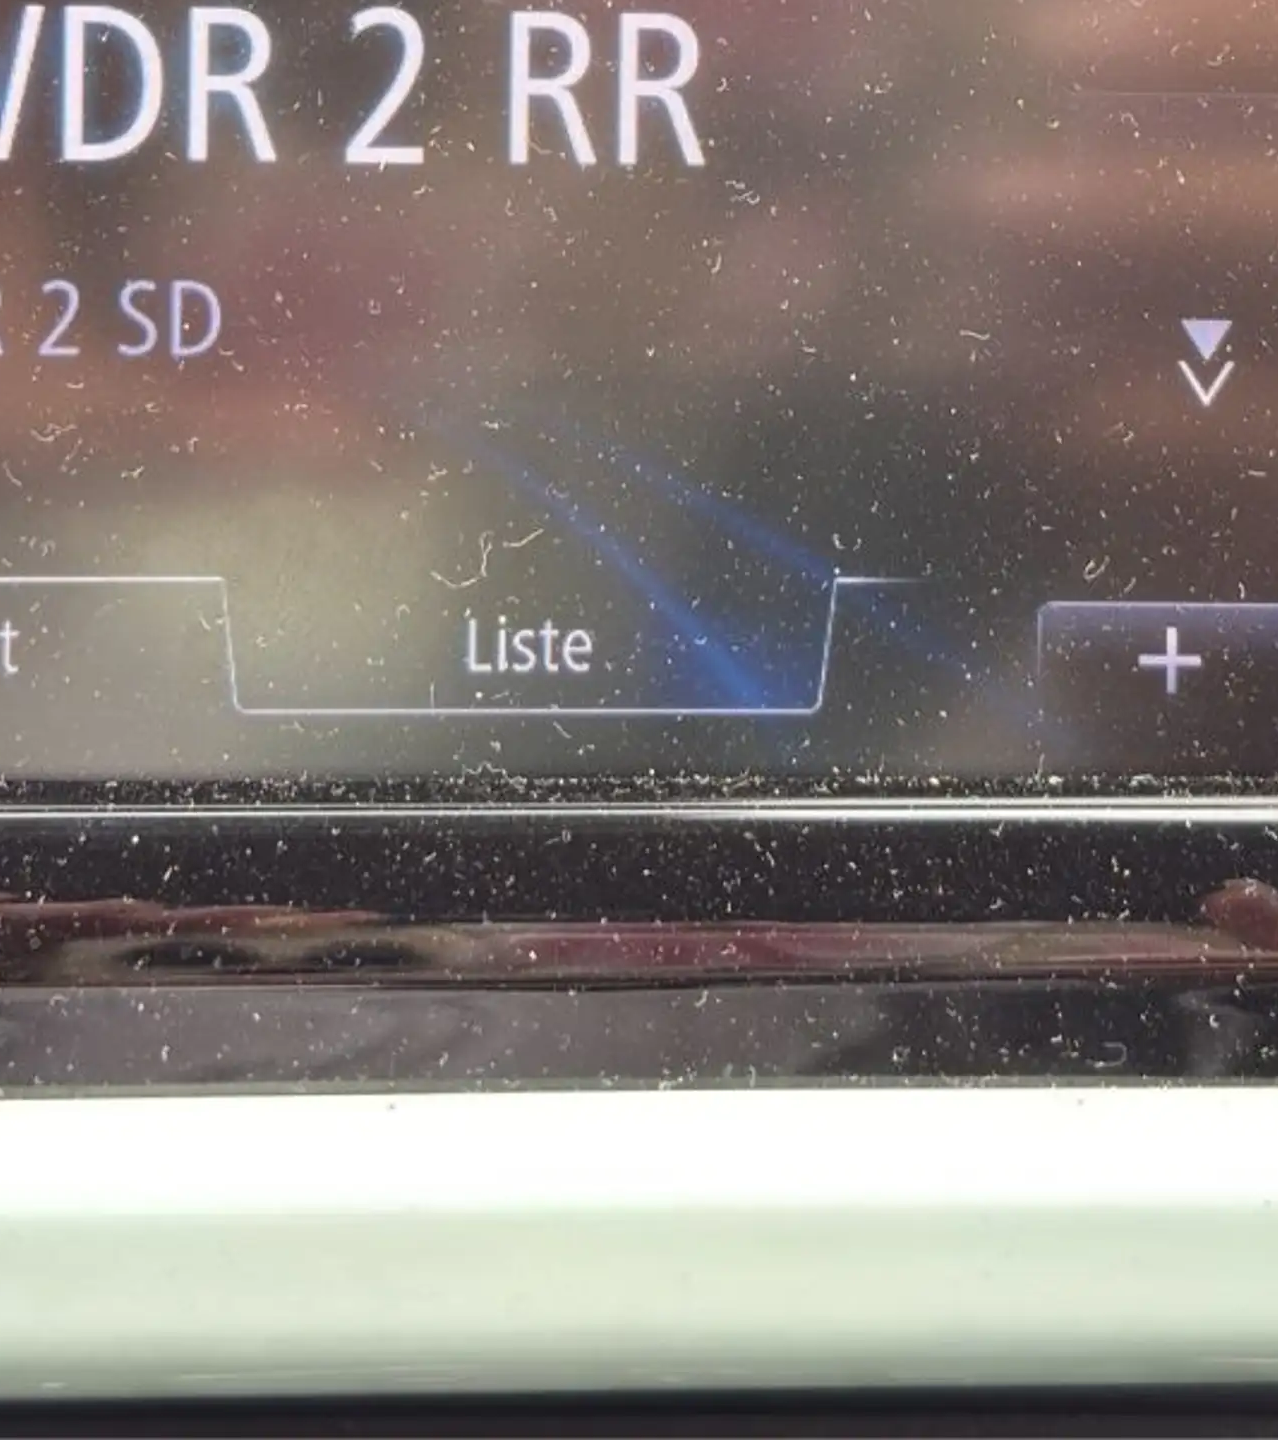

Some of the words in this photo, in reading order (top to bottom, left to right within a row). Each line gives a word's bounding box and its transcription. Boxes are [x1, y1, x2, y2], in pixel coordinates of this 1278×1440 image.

[348, 6, 424, 164] 2
[510, 10, 705, 165] RR
[40, 279, 79, 354] 2
[118, 279, 219, 355] SD
[464, 615, 594, 676] Liste
